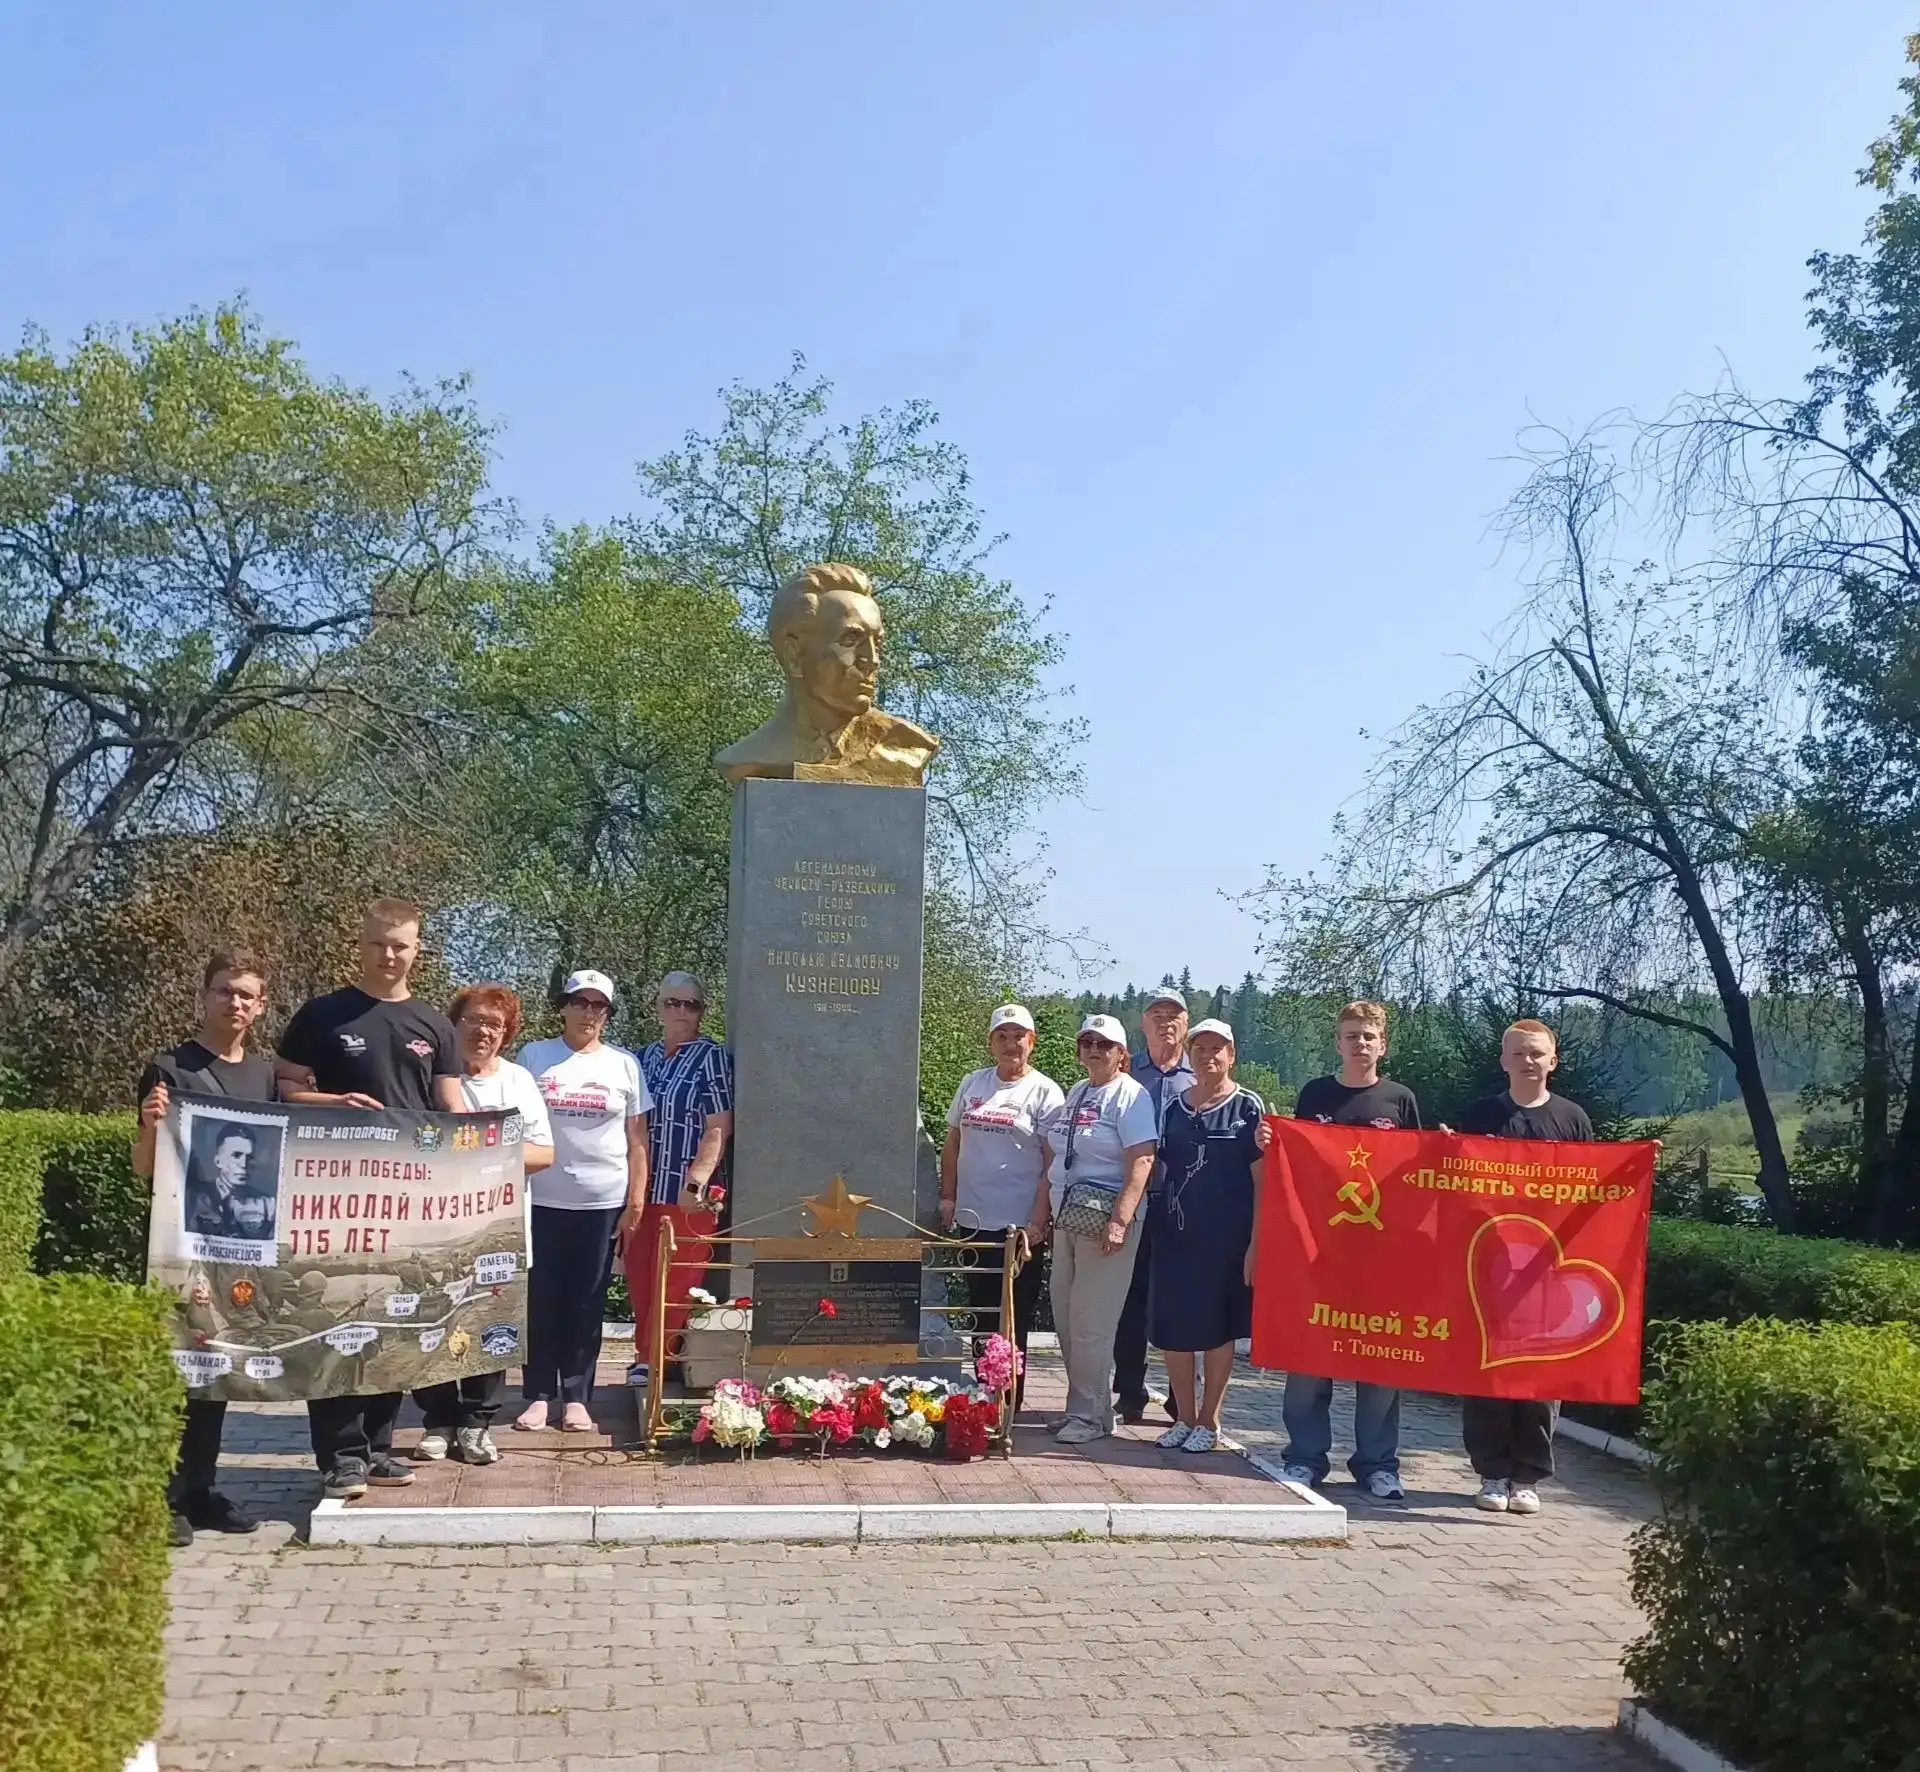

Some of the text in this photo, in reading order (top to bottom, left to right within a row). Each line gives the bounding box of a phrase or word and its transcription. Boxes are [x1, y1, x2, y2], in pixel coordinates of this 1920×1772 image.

[801, 911, 868, 928] СОВЕТСКОГО
[817, 931, 852, 945] СОЮЗА
[786, 972, 881, 996] КУЗНЕЦОВУ
[297, 1125, 399, 1141] АВТО-МОТОПРОБЕГ
[294, 1159, 431, 1181] ГЕРОИ ПОБЕДЫ:
[1442, 1156, 1599, 1182] ПОИСКОВЫЙ ОТРЯД
[1402, 1168, 1637, 1204] «Память сердца»
[291, 1192, 410, 1221] НИКОЛАЙ
[289, 1227, 391, 1255] 115 ЛЕТ
[1308, 1302, 1450, 1341] Лицей 34
[1332, 1338, 1425, 1363] г. Тюмень
